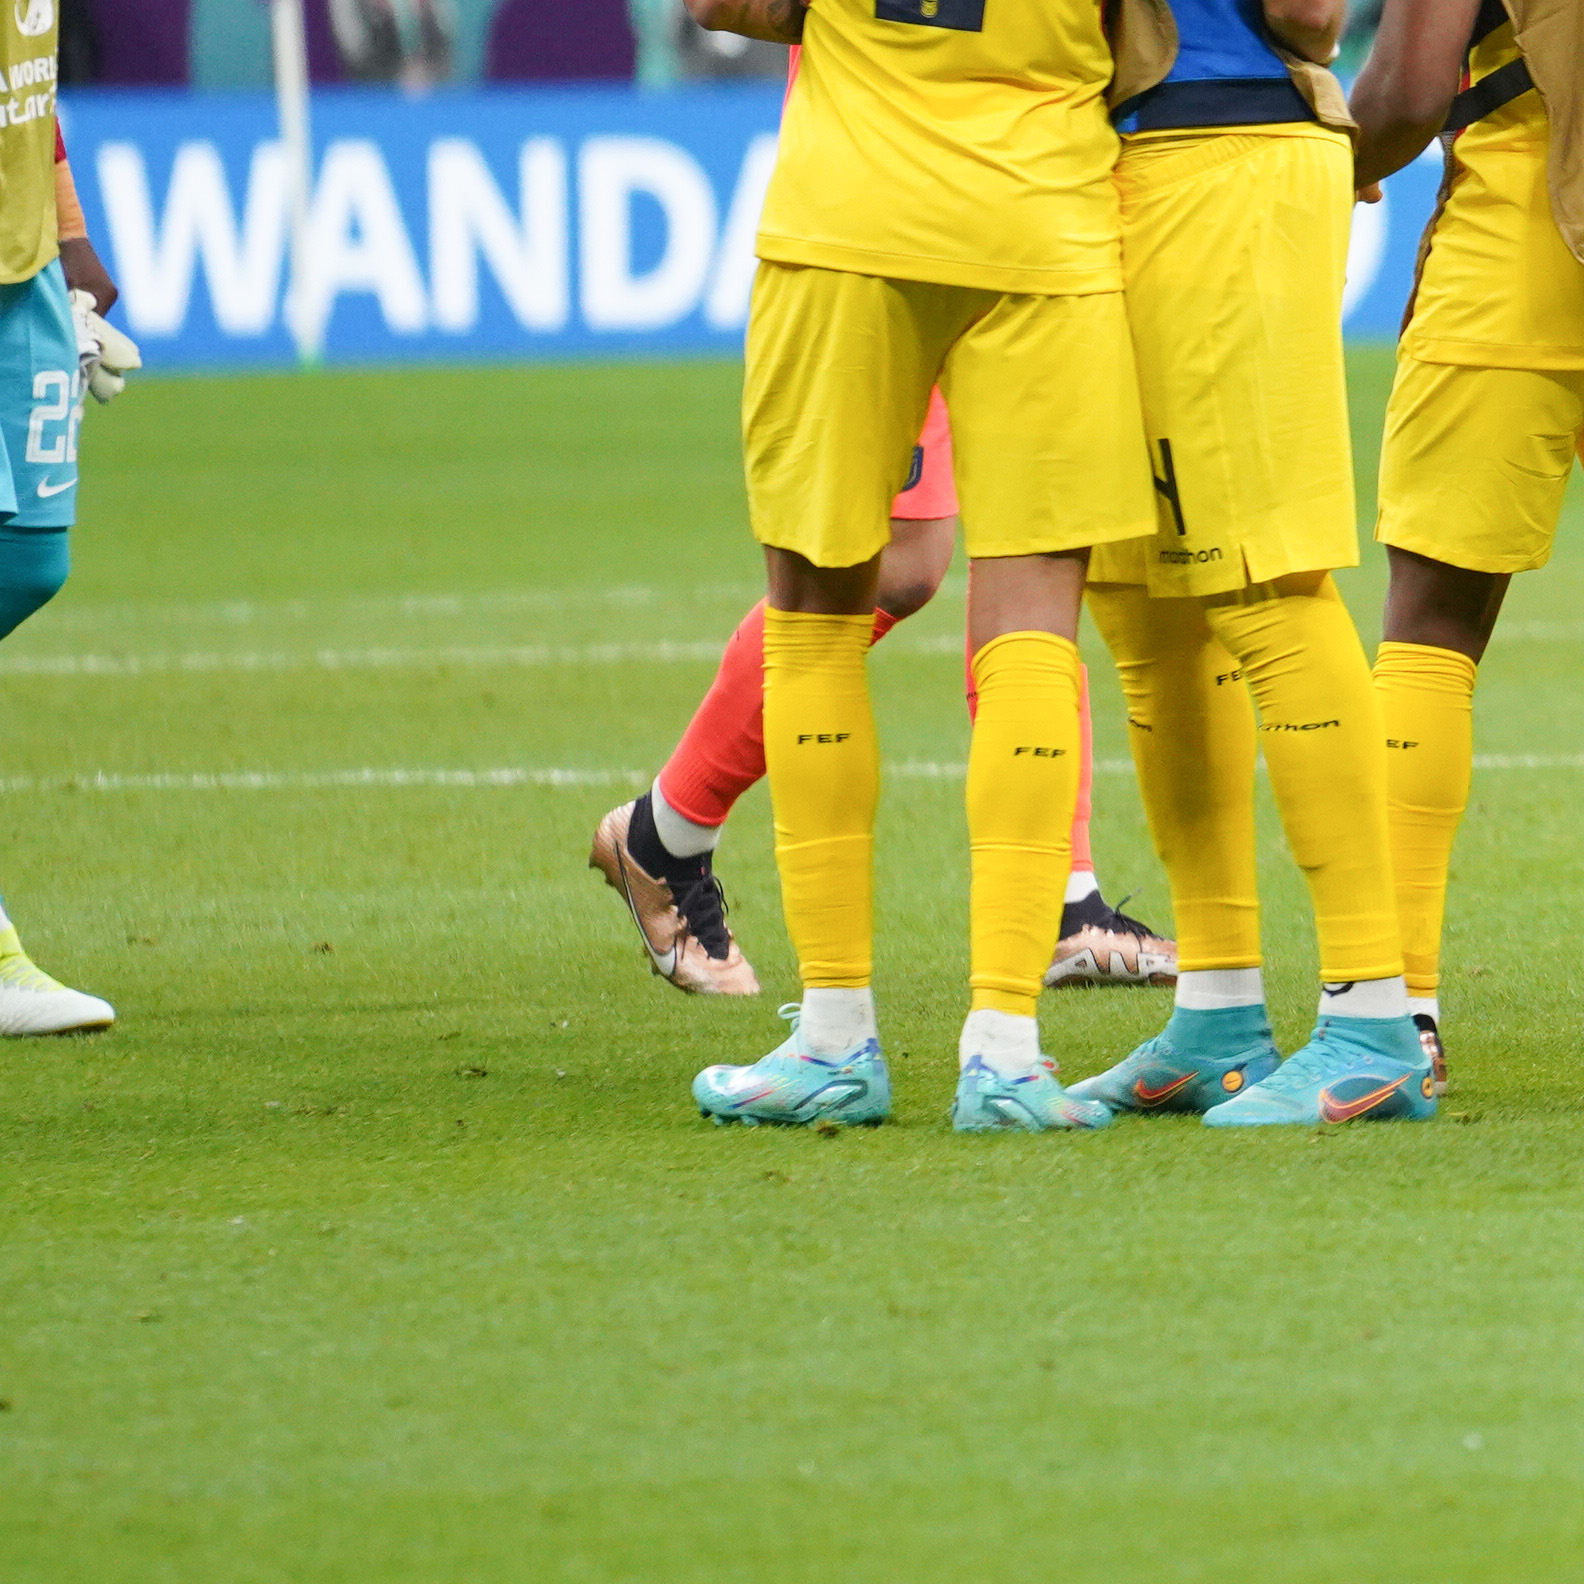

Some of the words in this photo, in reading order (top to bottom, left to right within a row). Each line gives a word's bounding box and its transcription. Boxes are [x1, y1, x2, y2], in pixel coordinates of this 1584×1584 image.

[797, 732, 851, 745] FEF
[1385, 738, 1420, 750] EF
[1013, 746, 1067, 759] FEF
